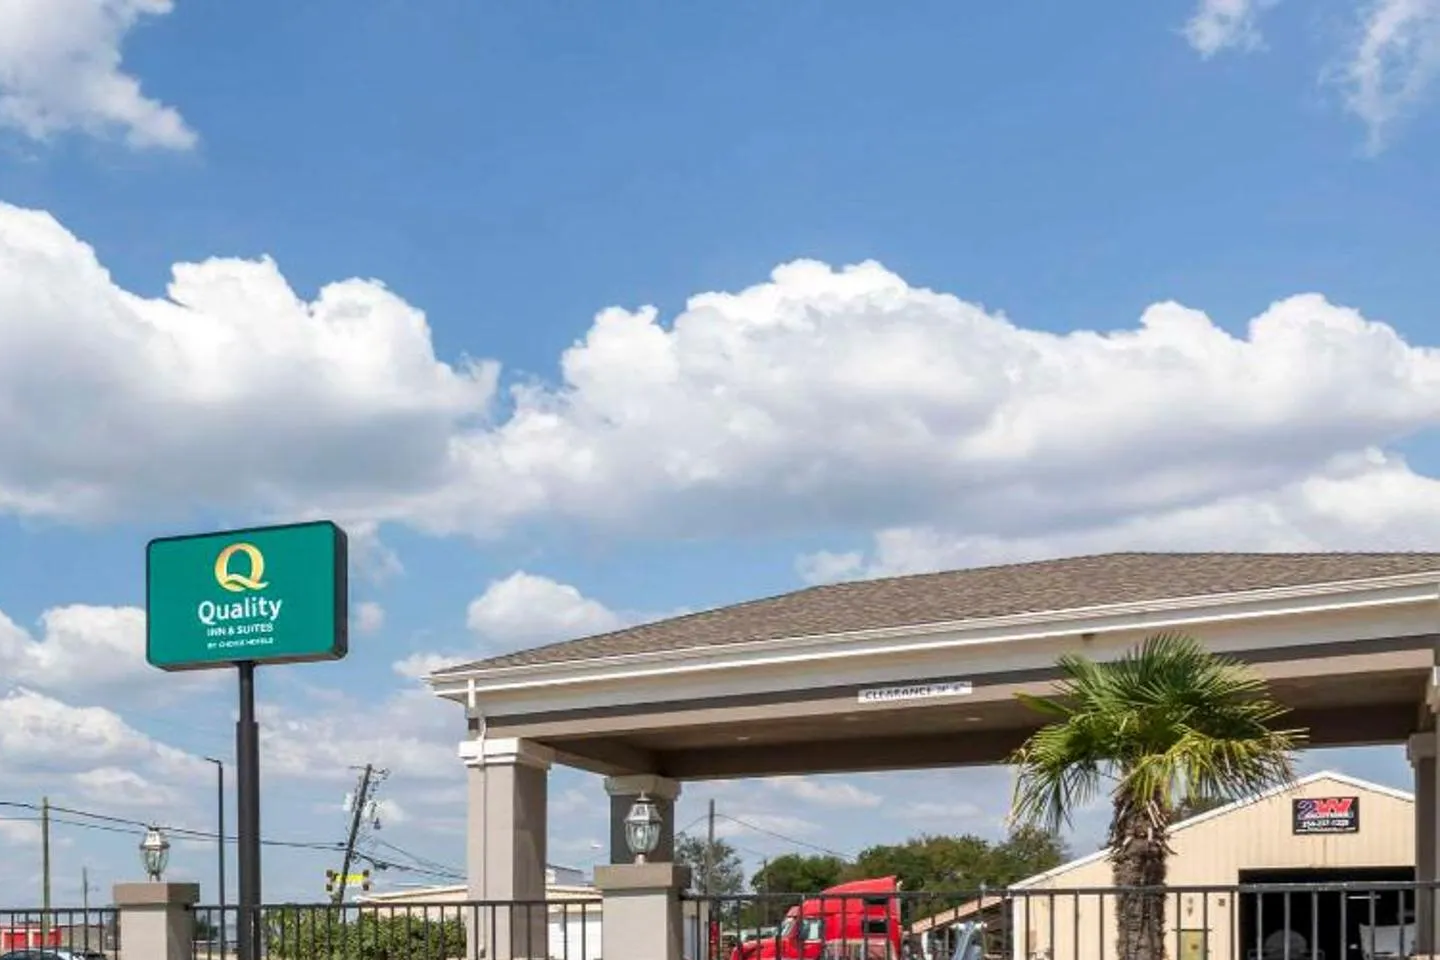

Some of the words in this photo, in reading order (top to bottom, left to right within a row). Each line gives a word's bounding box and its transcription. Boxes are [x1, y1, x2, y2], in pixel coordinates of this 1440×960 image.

[197, 596, 283, 625] Quality
[206, 626, 227, 637] INN
[227, 625, 235, 636] &
[236, 622, 274, 635] SUITES
[865, 685, 932, 700] CLEARANCE
